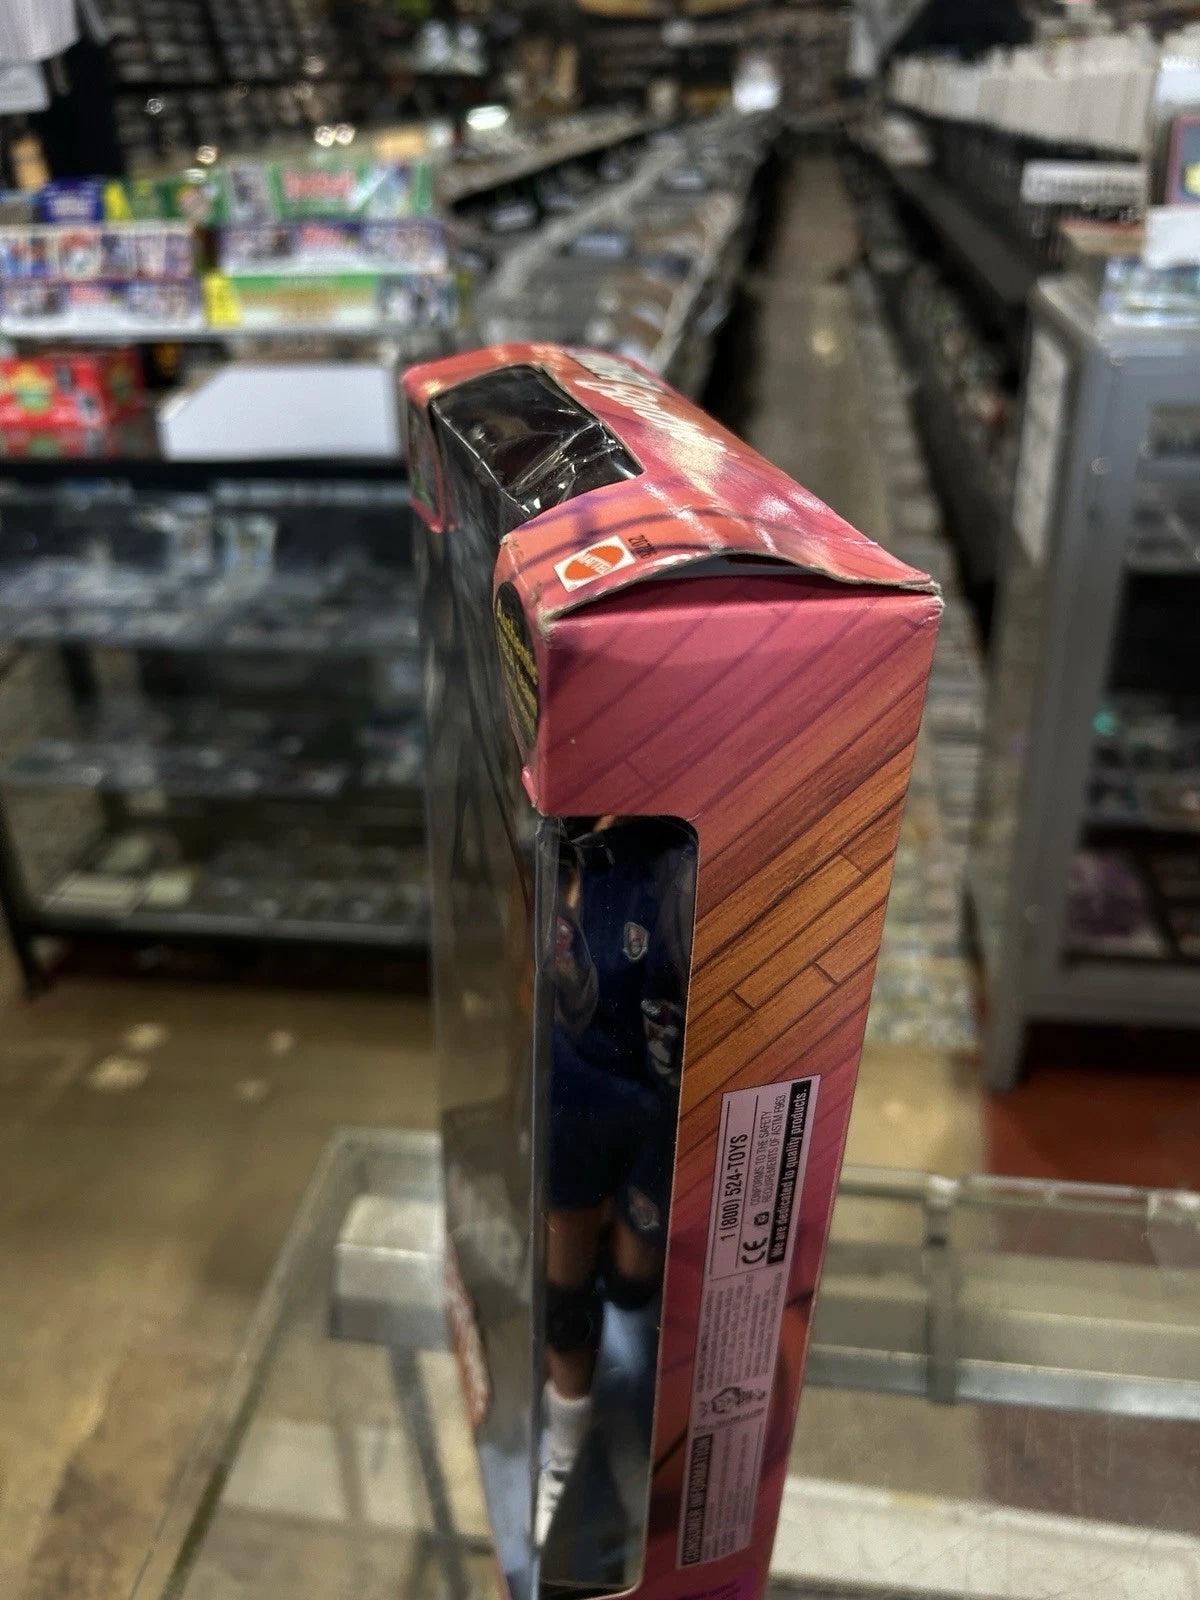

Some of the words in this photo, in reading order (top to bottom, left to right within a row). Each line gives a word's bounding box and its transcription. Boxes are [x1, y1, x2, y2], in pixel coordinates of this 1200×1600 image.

[791, 1088, 807, 1134] products.
[758, 1111, 772, 1138] SAFETY
[771, 1114, 782, 1135] ASTM
[757, 1140, 768, 1154] THE
[768, 1136, 779, 1146] OF
[783, 1135, 804, 1168] quality
[726, 1134, 748, 1196] 524-TOYS
[755, 1155, 765, 1165] TO
[750, 1166, 765, 1206] CONFORMS
[764, 1147, 779, 1202] REQUIREMENTS
[781, 1170, 794, 1180] to
[721, 1198, 741, 1230] (800)
[774, 1181, 794, 1223] dedicated
[720, 1233, 736, 1241] 1
[774, 1226, 786, 1240] are
[771, 1241, 784, 1257] We
